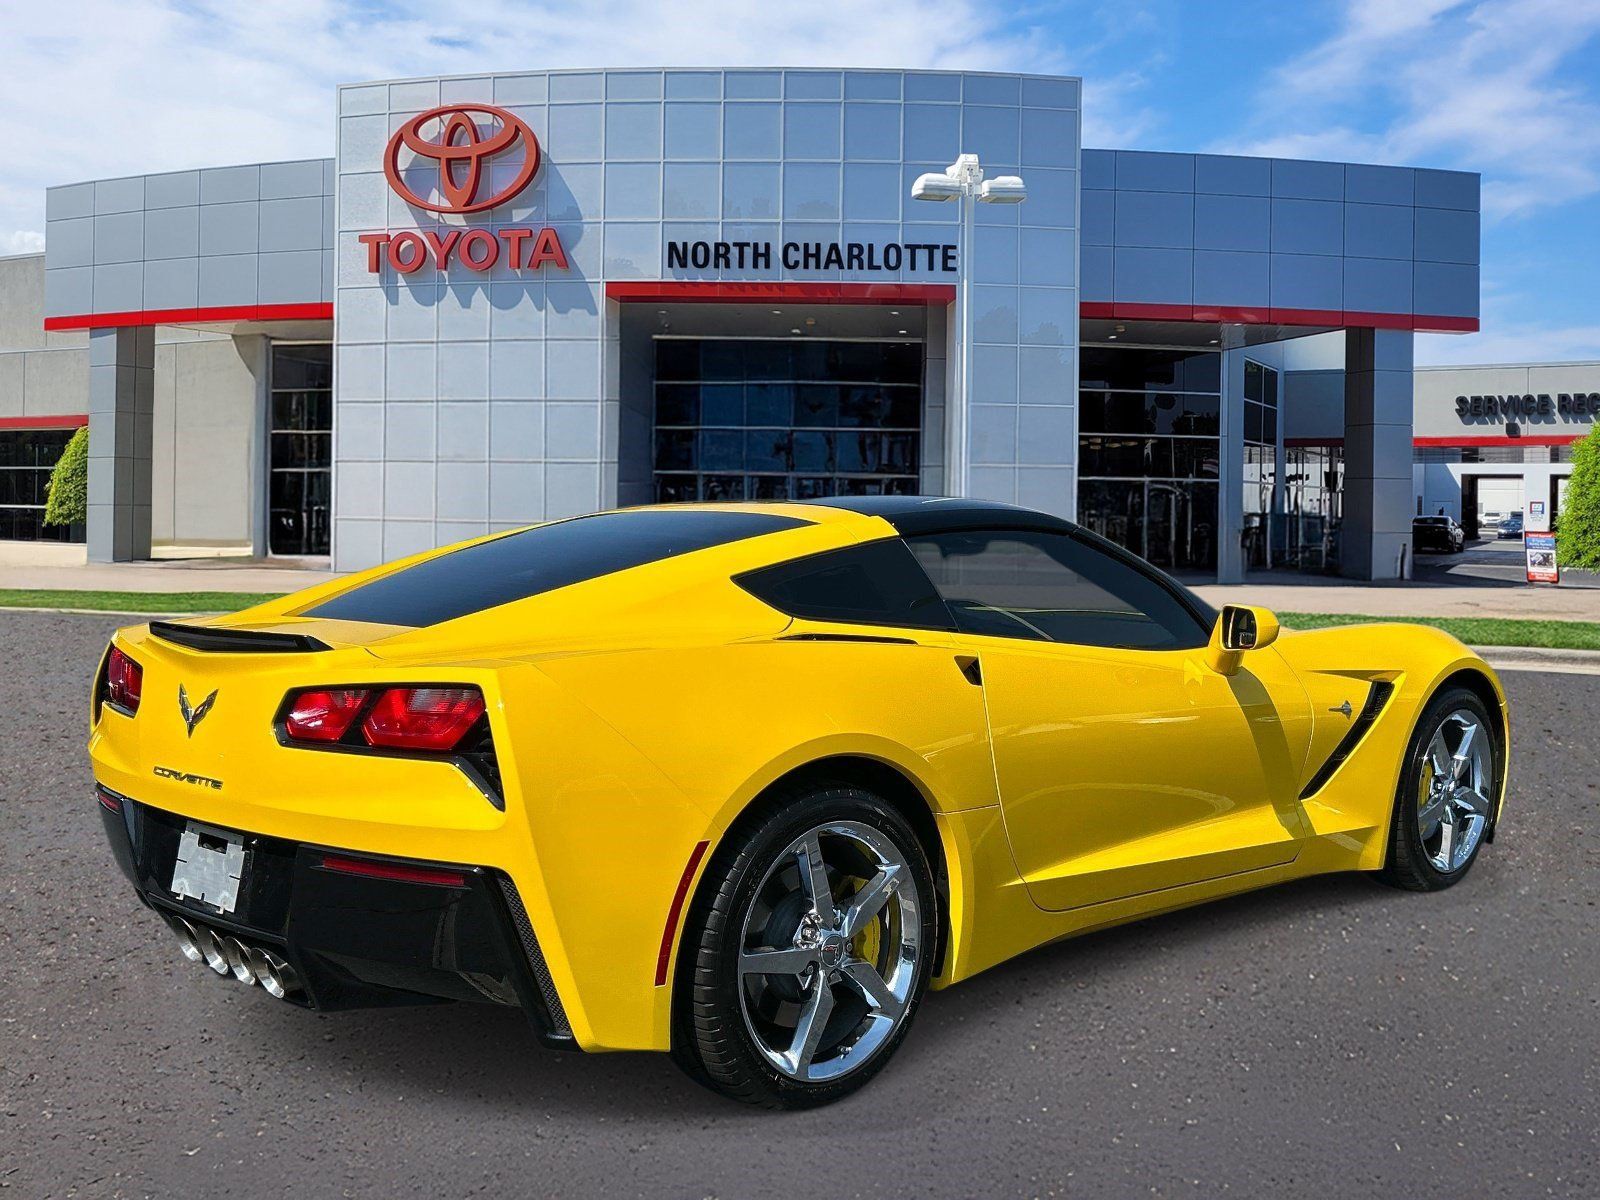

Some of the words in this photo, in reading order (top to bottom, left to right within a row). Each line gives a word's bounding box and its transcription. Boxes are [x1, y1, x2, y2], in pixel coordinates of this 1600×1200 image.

[359, 228, 569, 273] TOYOTA
[667, 241, 771, 269] NORTH
[782, 242, 957, 272] CHARLOTTE
[1455, 394, 1552, 417] SERVICE
[1558, 393, 1600, 415] REC
[153, 766, 223, 790] CORVETTE
